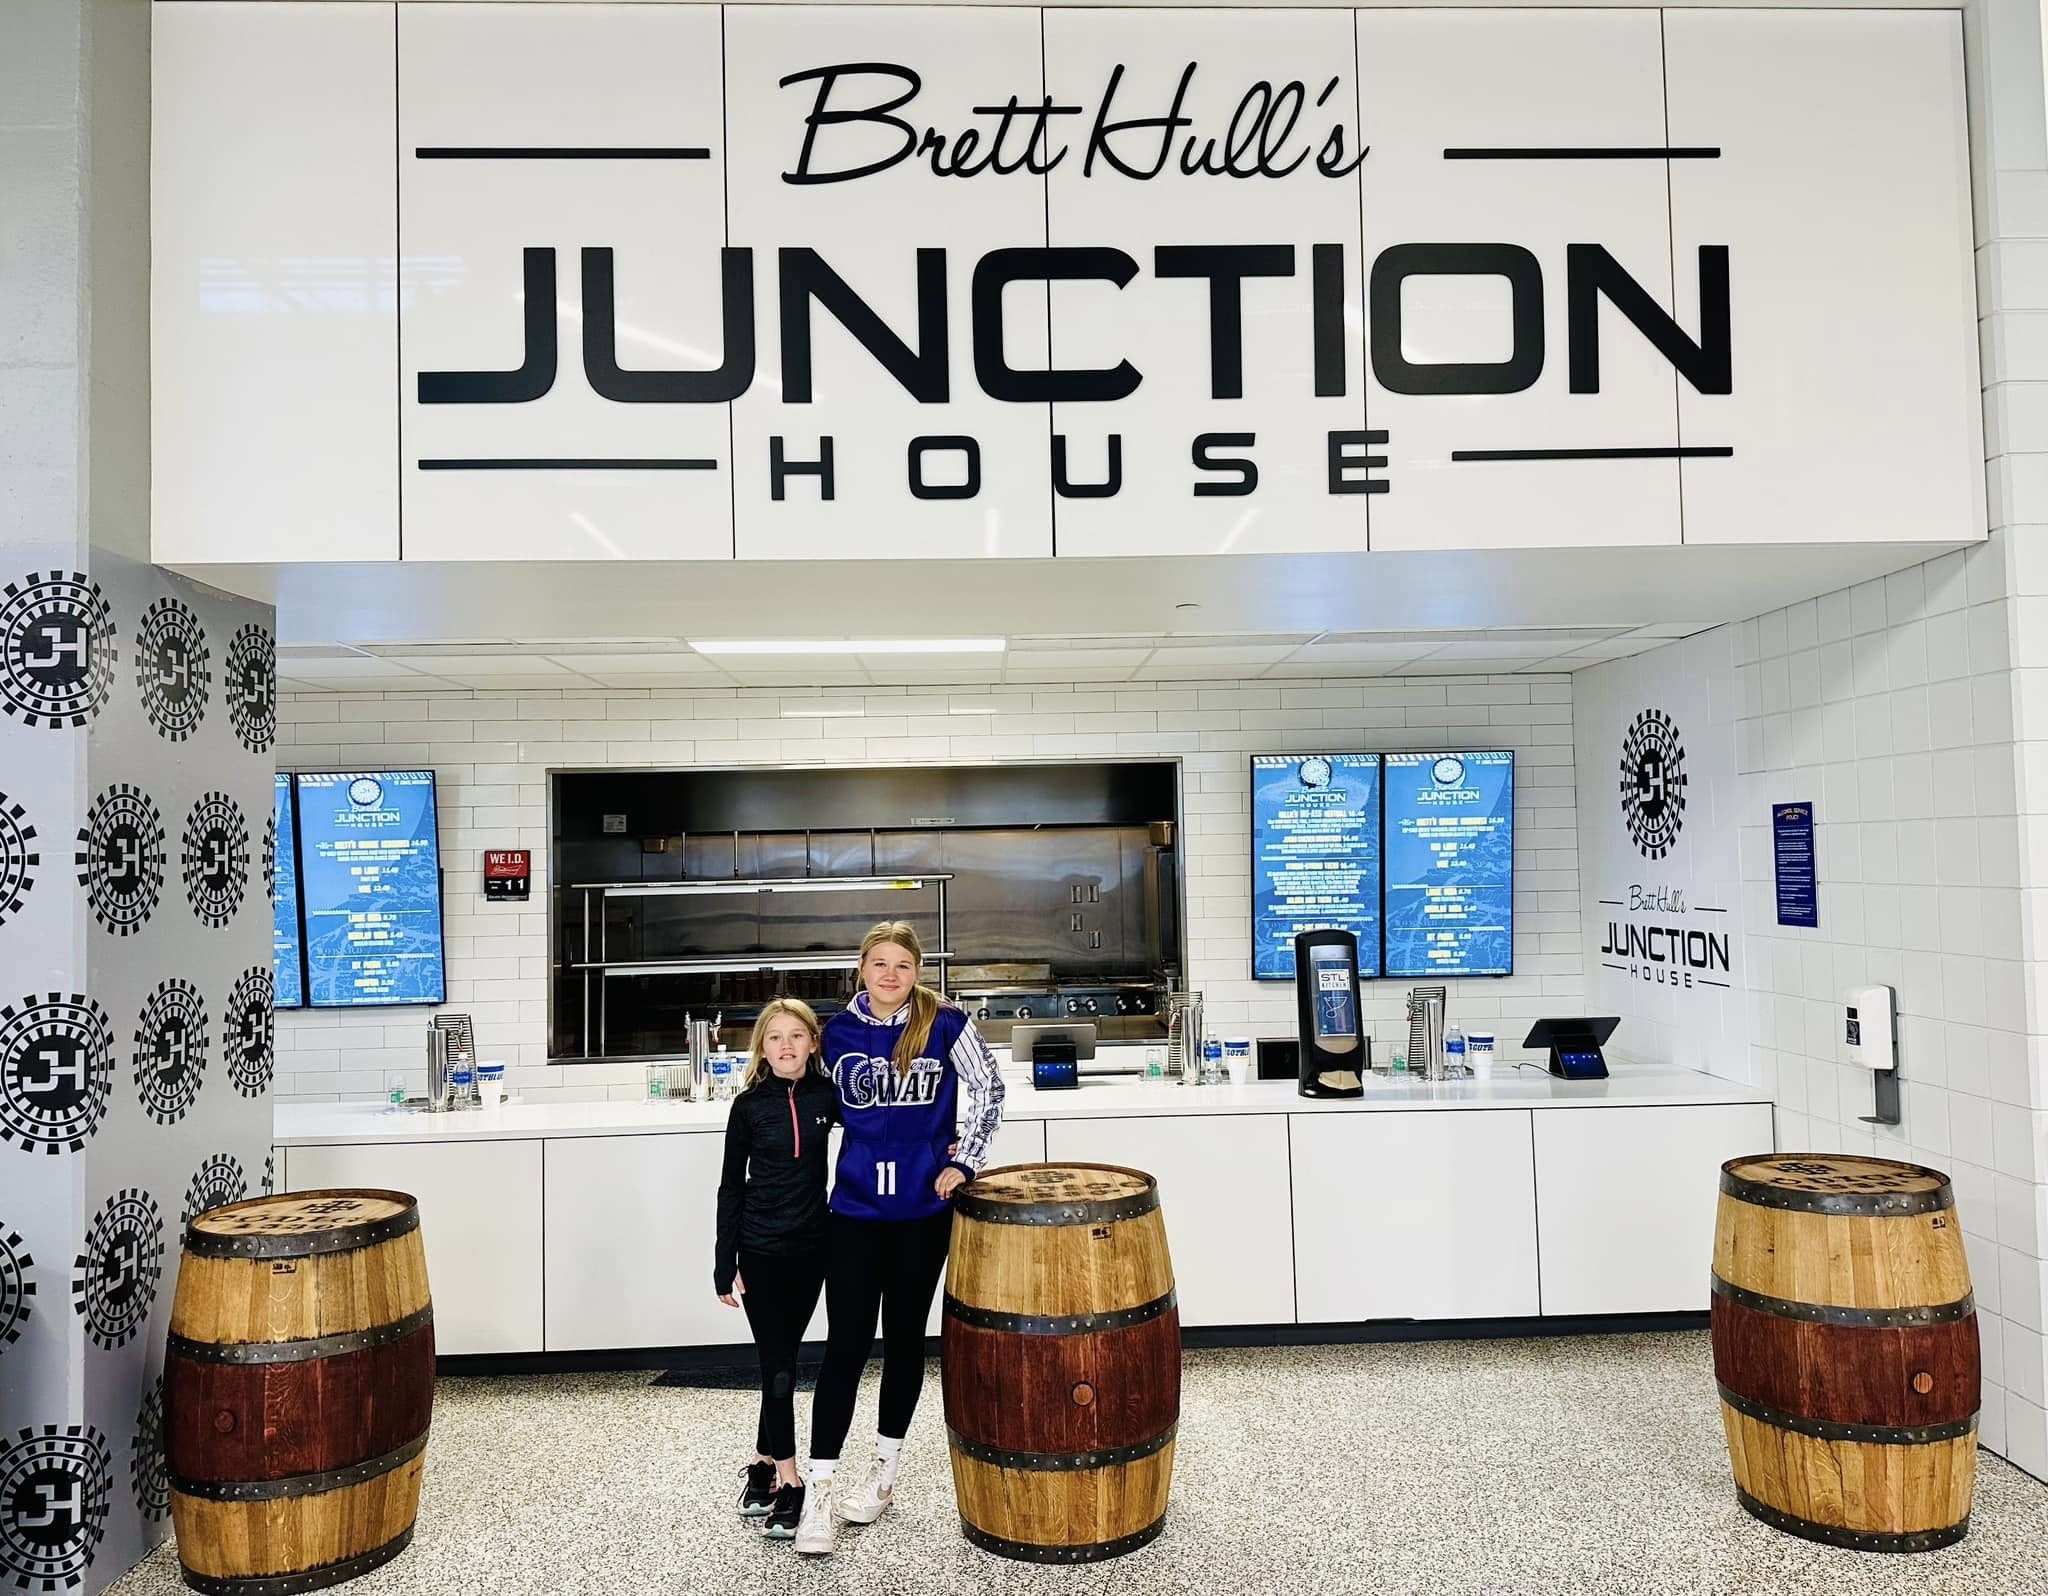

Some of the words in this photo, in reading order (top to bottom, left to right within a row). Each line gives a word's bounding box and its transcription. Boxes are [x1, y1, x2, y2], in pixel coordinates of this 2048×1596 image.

[779, 62, 1082, 184] Brett
[1082, 61, 1370, 181] Hull's
[418, 243, 1732, 404] JUNCTION
[770, 430, 1391, 500] HOUSE
[1285, 793, 1346, 803] JUNCTION
[1417, 791, 1480, 801] JUNCTION
[334, 811, 400, 823] JUNCTION
[490, 853, 505, 864] WE
[507, 853, 524, 864] I.D.
[1628, 884, 1657, 911] Brett
[1601, 921, 1730, 972] JUNCTION
[1321, 973, 1346, 982] STL
[1630, 963, 1692, 988] HOUSE
[858, 1070, 941, 1105] SWAT
[876, 1162, 896, 1195] 11
